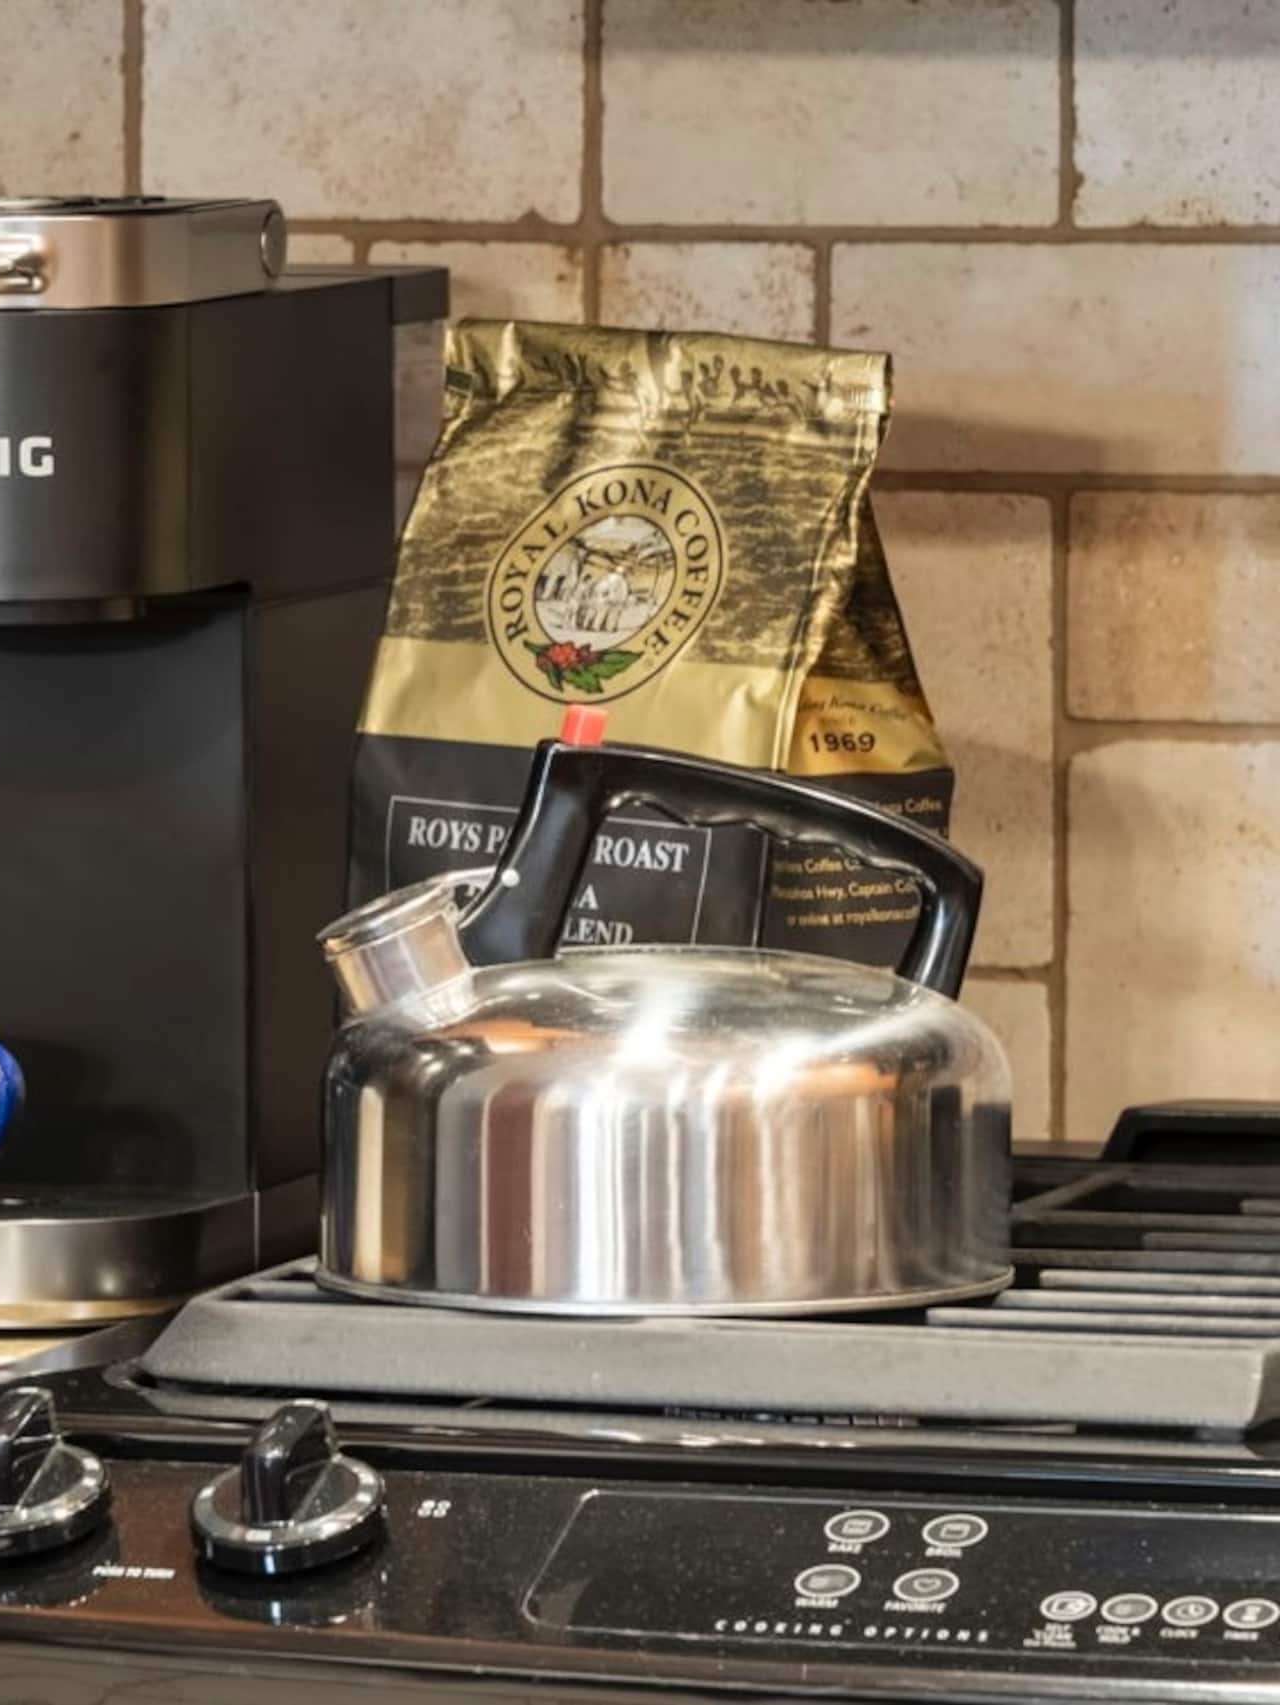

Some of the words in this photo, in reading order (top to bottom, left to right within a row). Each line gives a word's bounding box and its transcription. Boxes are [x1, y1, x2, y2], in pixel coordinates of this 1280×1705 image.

[500, 520, 569, 642] ROYAL
[575, 479, 673, 518] KONA
[645, 509, 709, 655] COFFEE
[810, 732, 876, 753] 1969
[408, 816, 483, 853] ROYS
[594, 835, 690, 871] ROAST
[561, 917, 634, 945] LEND
[714, 1618, 843, 1637] COOKING
[863, 1625, 989, 1643] OPTIONS
